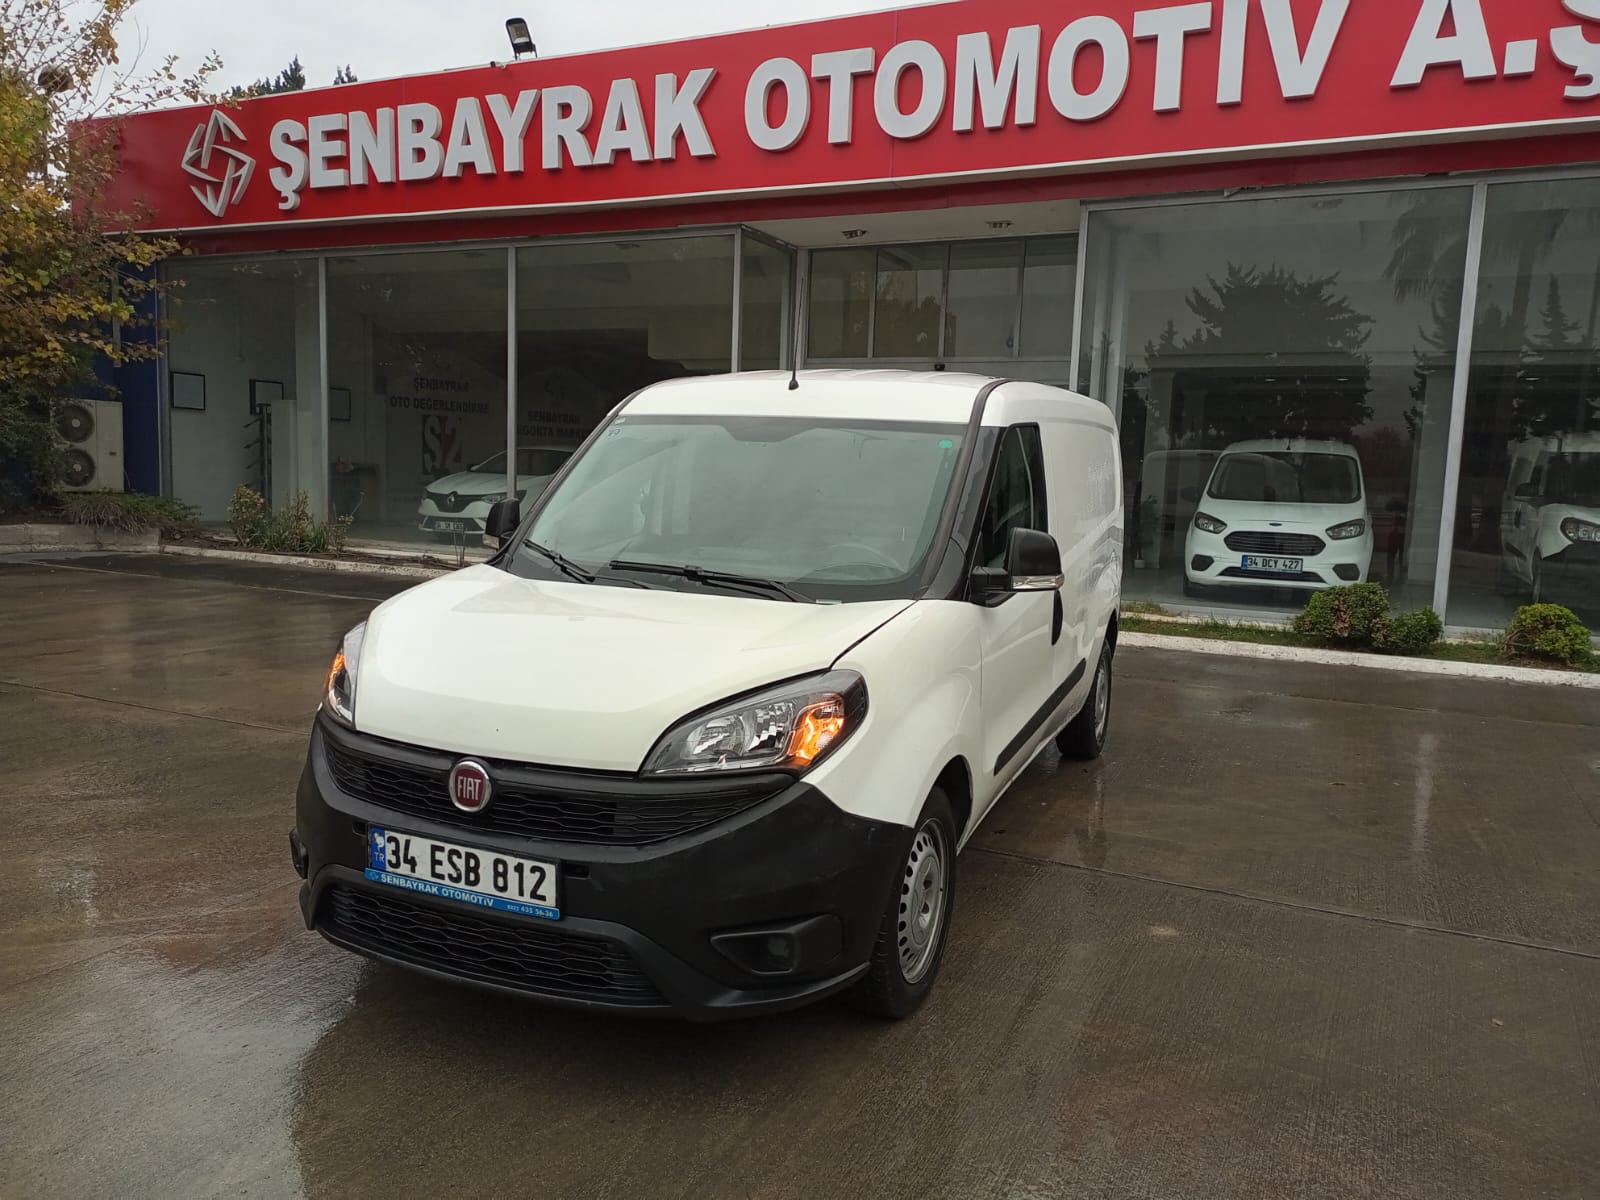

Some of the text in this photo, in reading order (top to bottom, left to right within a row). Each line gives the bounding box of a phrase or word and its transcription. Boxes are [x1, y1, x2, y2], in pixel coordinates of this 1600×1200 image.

[269, 67, 717, 210] ŞENBAYRAK
[390, 396, 411, 409] OTO
[1248, 557, 1300, 570] 34 DCY 427
[457, 775, 482, 801] FIAT
[373, 851, 385, 863] TR
[386, 835, 547, 902] 34 ESB 812
